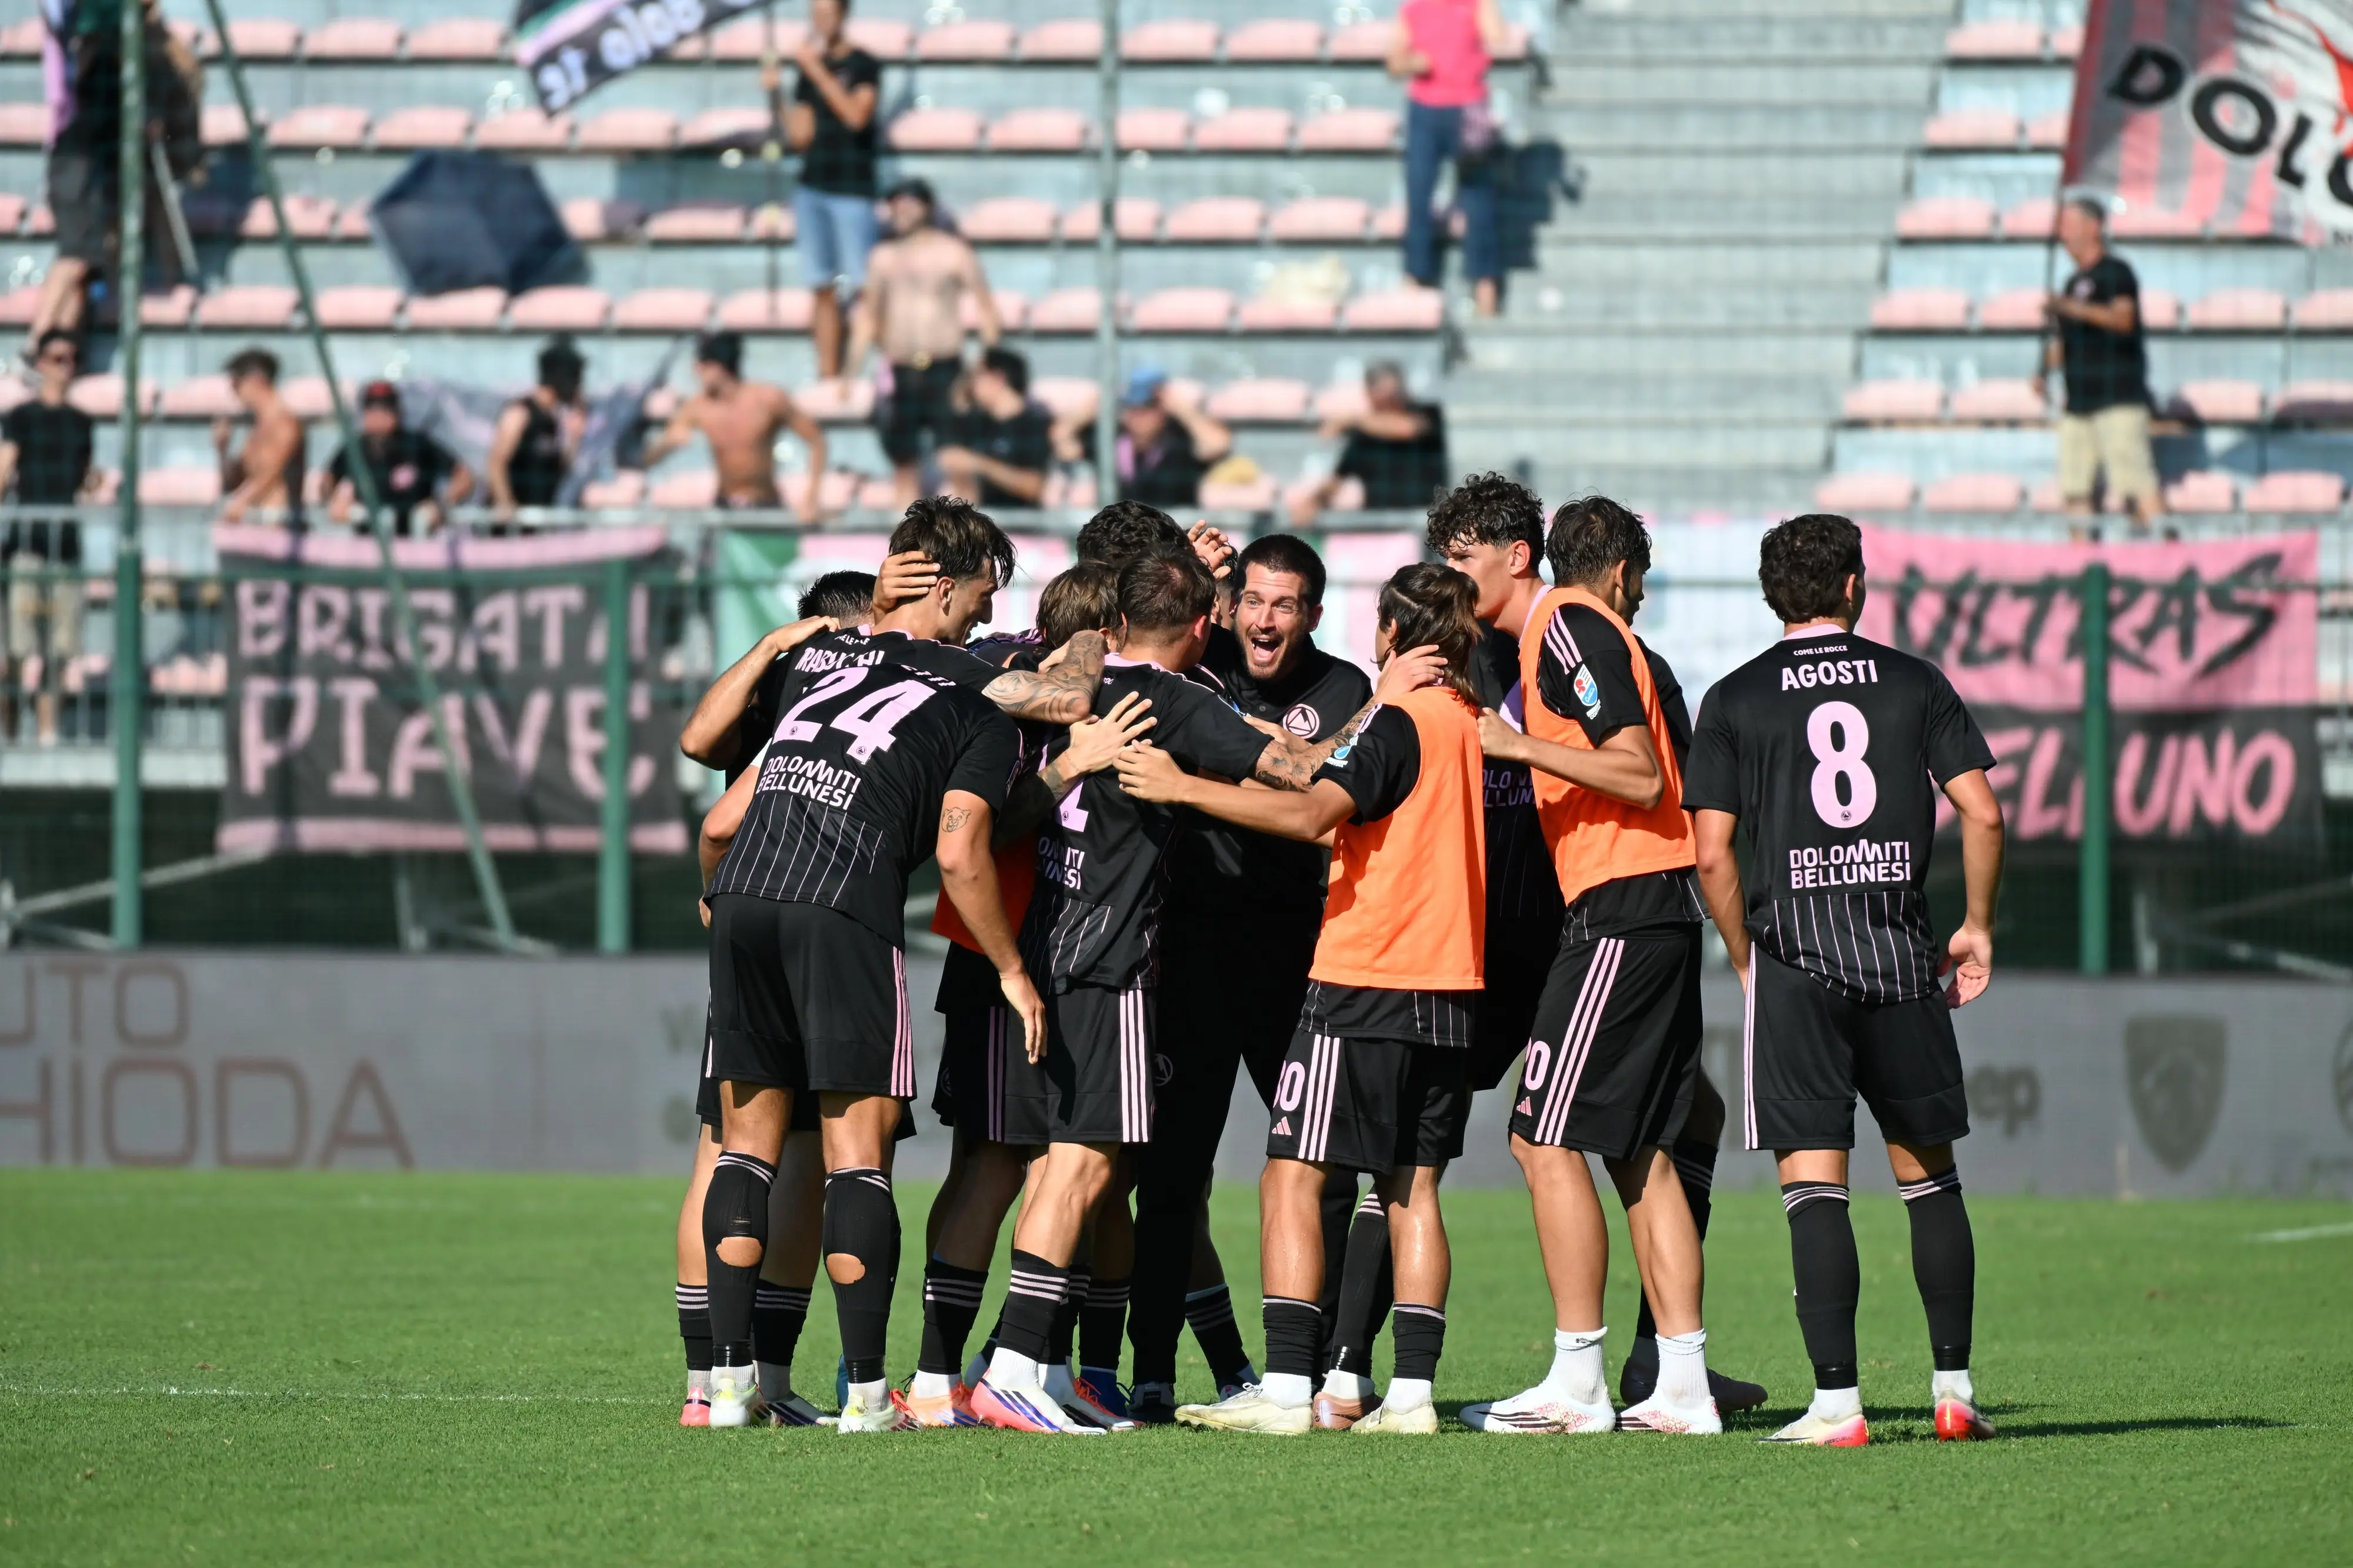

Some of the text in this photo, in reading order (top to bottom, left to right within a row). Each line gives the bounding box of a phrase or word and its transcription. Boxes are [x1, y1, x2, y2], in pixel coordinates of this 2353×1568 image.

[1781, 659, 1878, 692] AGOSTI
[1793, 645, 1848, 656] COME LE ROCCE
[239, 675, 656, 801] PIAVE
[771, 666, 938, 765] 24
[1806, 700, 1878, 829] 8
[755, 773, 854, 811] BELLUNESI
[1791, 862, 1911, 890] BELLUNESI
[1272, 1059, 1306, 1112] 0
[1524, 1036, 1551, 1091] 0
